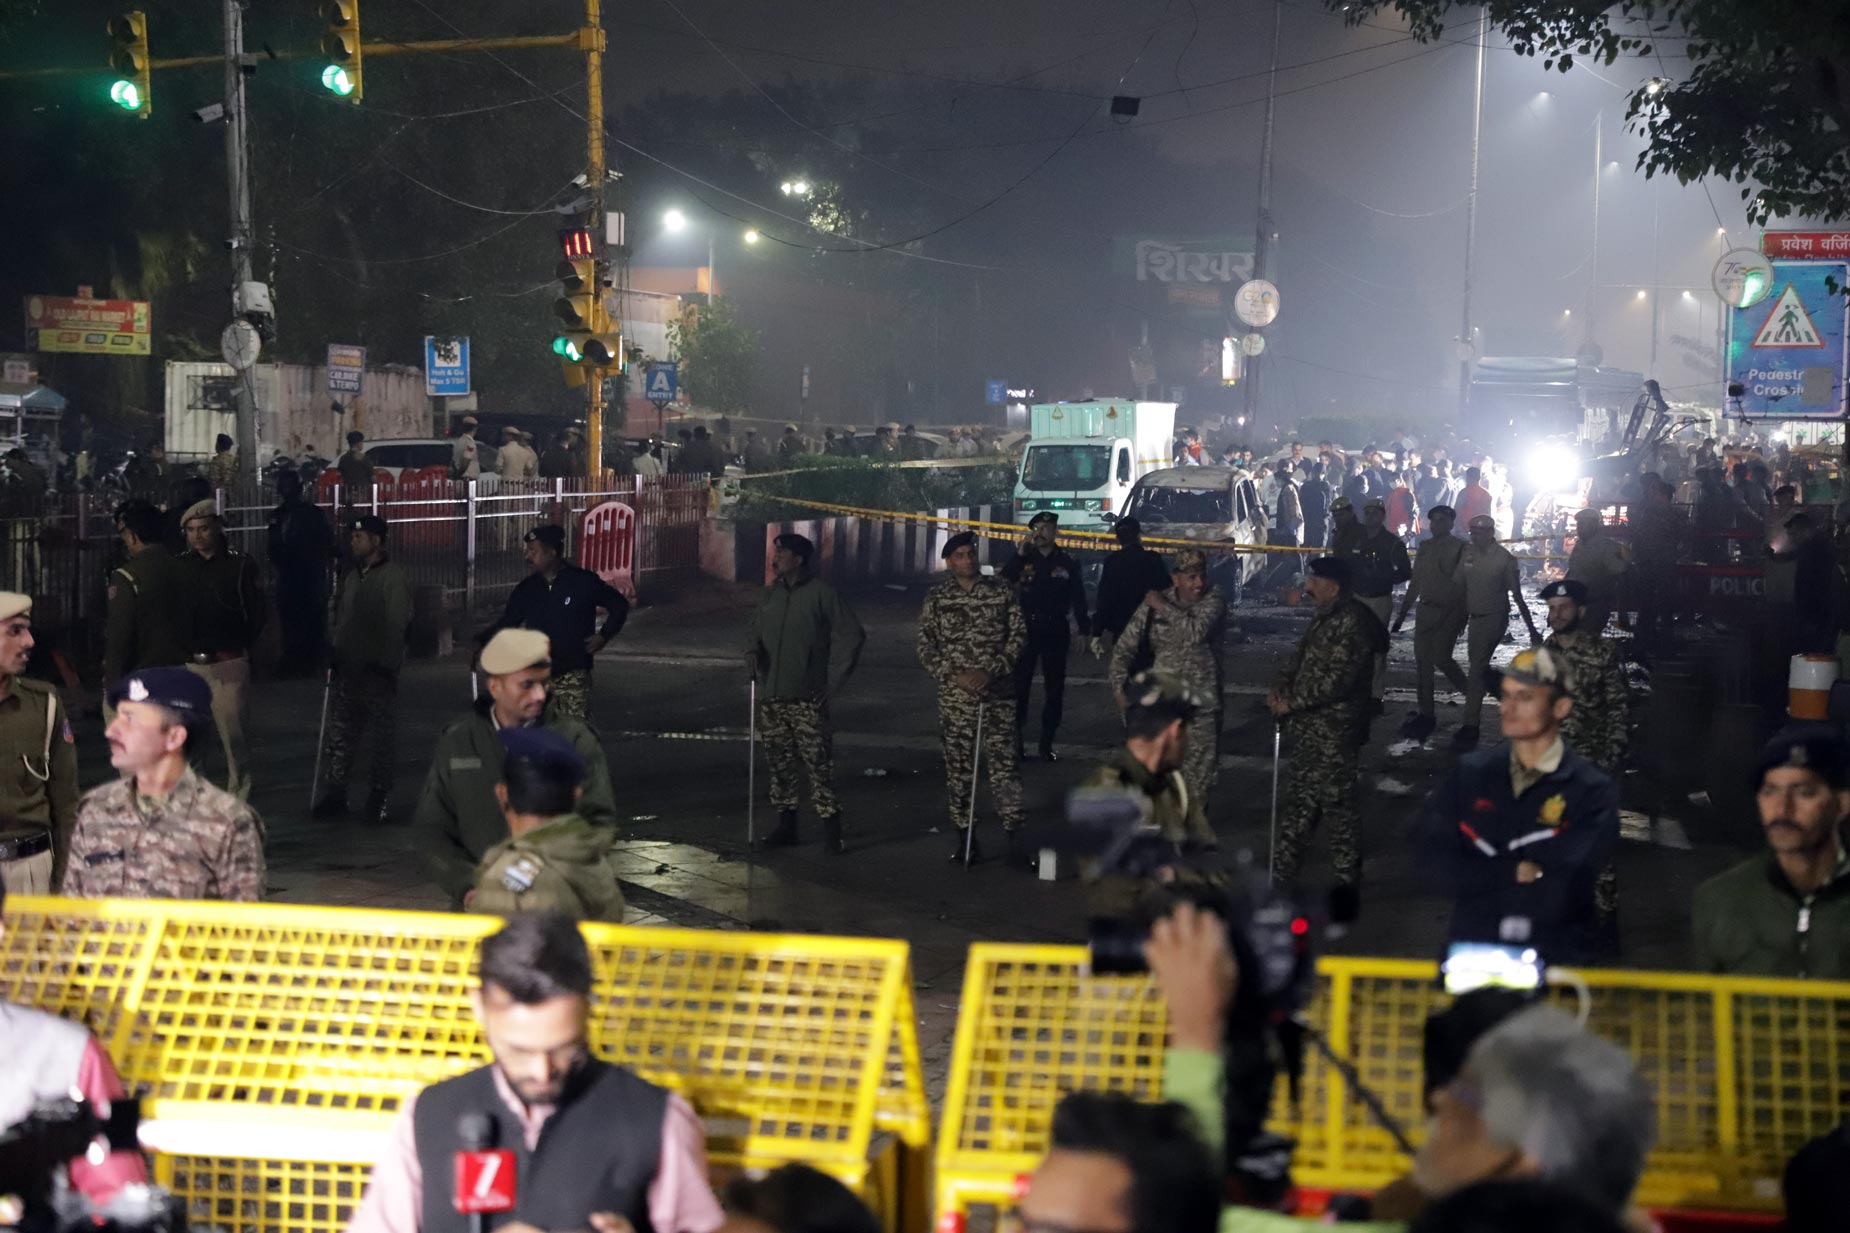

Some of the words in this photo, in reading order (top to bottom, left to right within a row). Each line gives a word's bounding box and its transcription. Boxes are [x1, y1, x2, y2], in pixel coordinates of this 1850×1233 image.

[1781, 235, 1813, 251] प्रवेश
[1821, 235, 1850, 251] वर्जि
[651, 371, 671, 391] A
[1749, 369, 1805, 381] Pedestr
[647, 391, 674, 399] ENTRY
